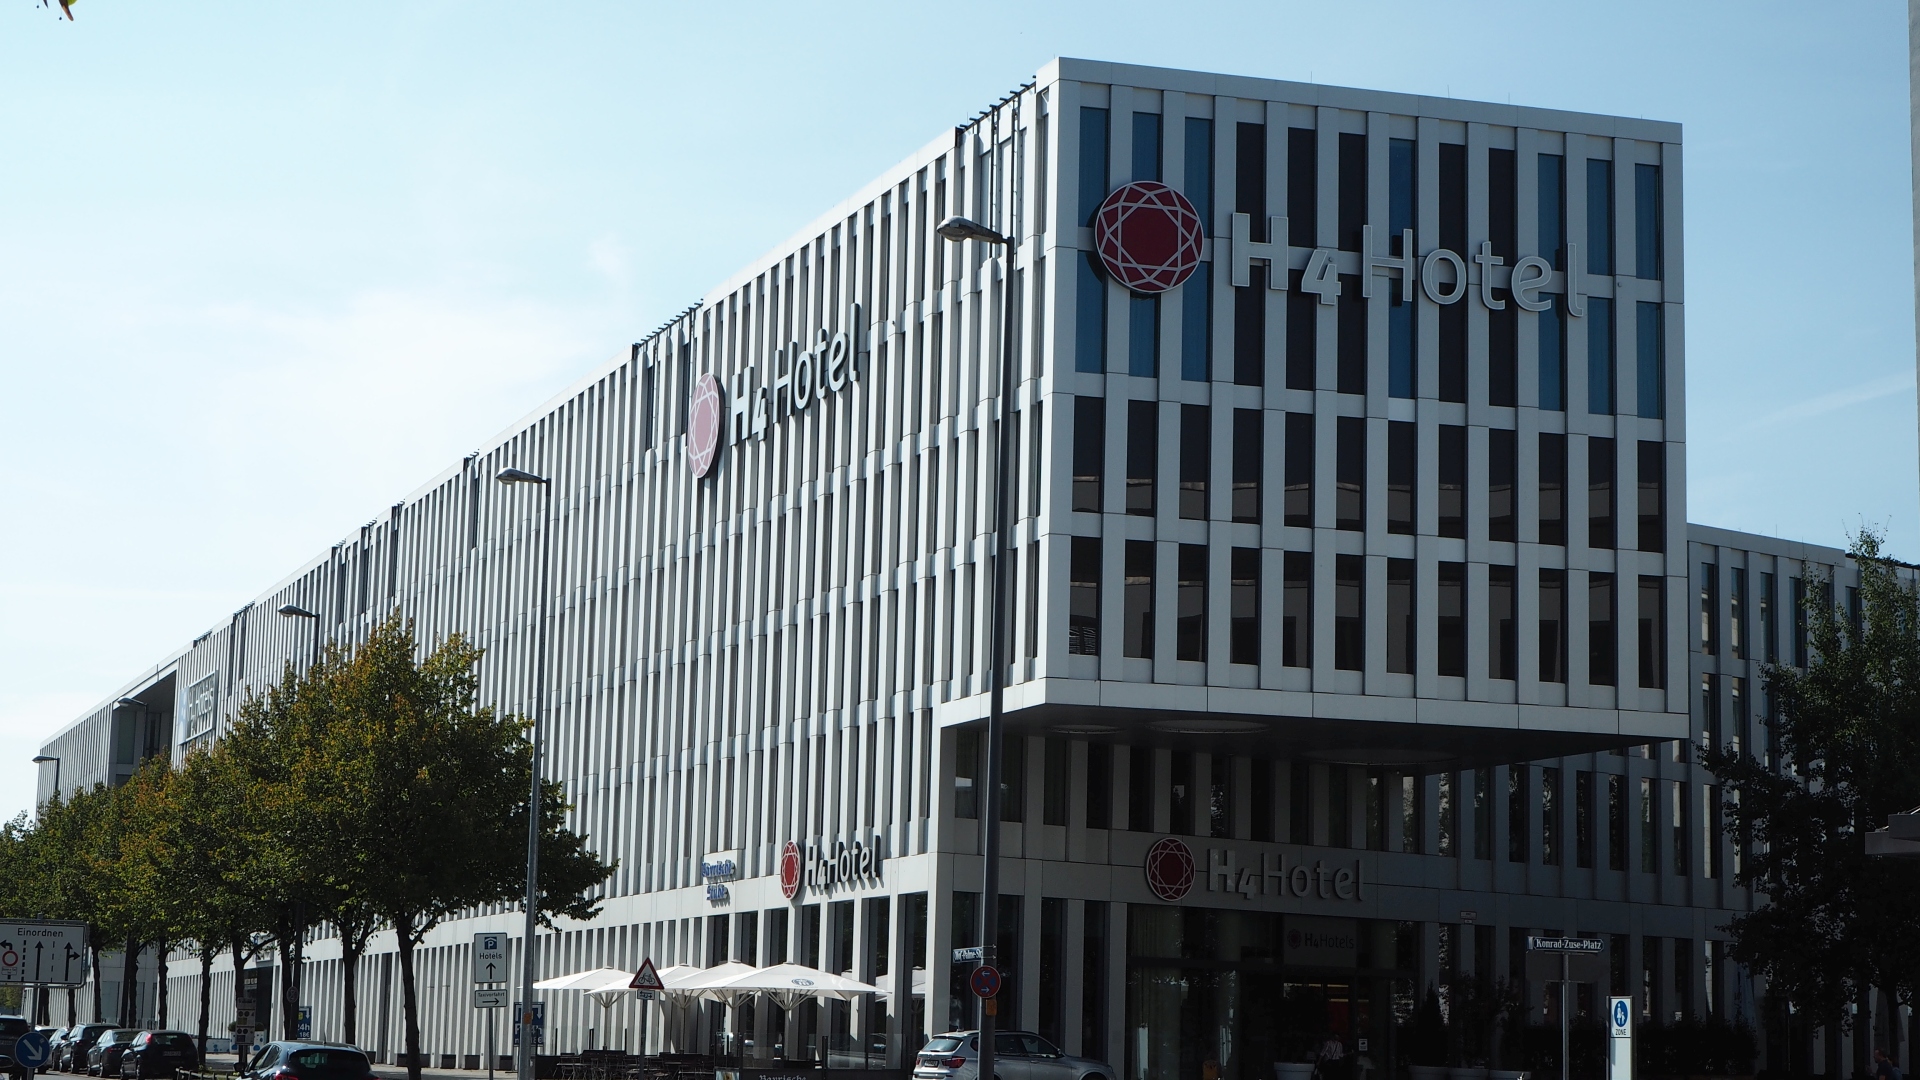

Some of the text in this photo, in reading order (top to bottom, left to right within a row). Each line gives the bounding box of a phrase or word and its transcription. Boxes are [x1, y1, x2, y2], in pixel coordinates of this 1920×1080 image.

[1231, 212, 1585, 318] H4Hotel
[730, 303, 859, 446] H4Hotel
[804, 835, 878, 890] H4Hotel
[1206, 848, 1364, 901] H4Hotel
[17, 927, 64, 938] Einordnen
[1304, 933, 1355, 949] H4Hotels
[1536, 938, 1602, 951] Konrad-Zuse-Platz
[479, 951, 503, 960] Hotels
[1615, 1028, 1627, 1036] ZONE
